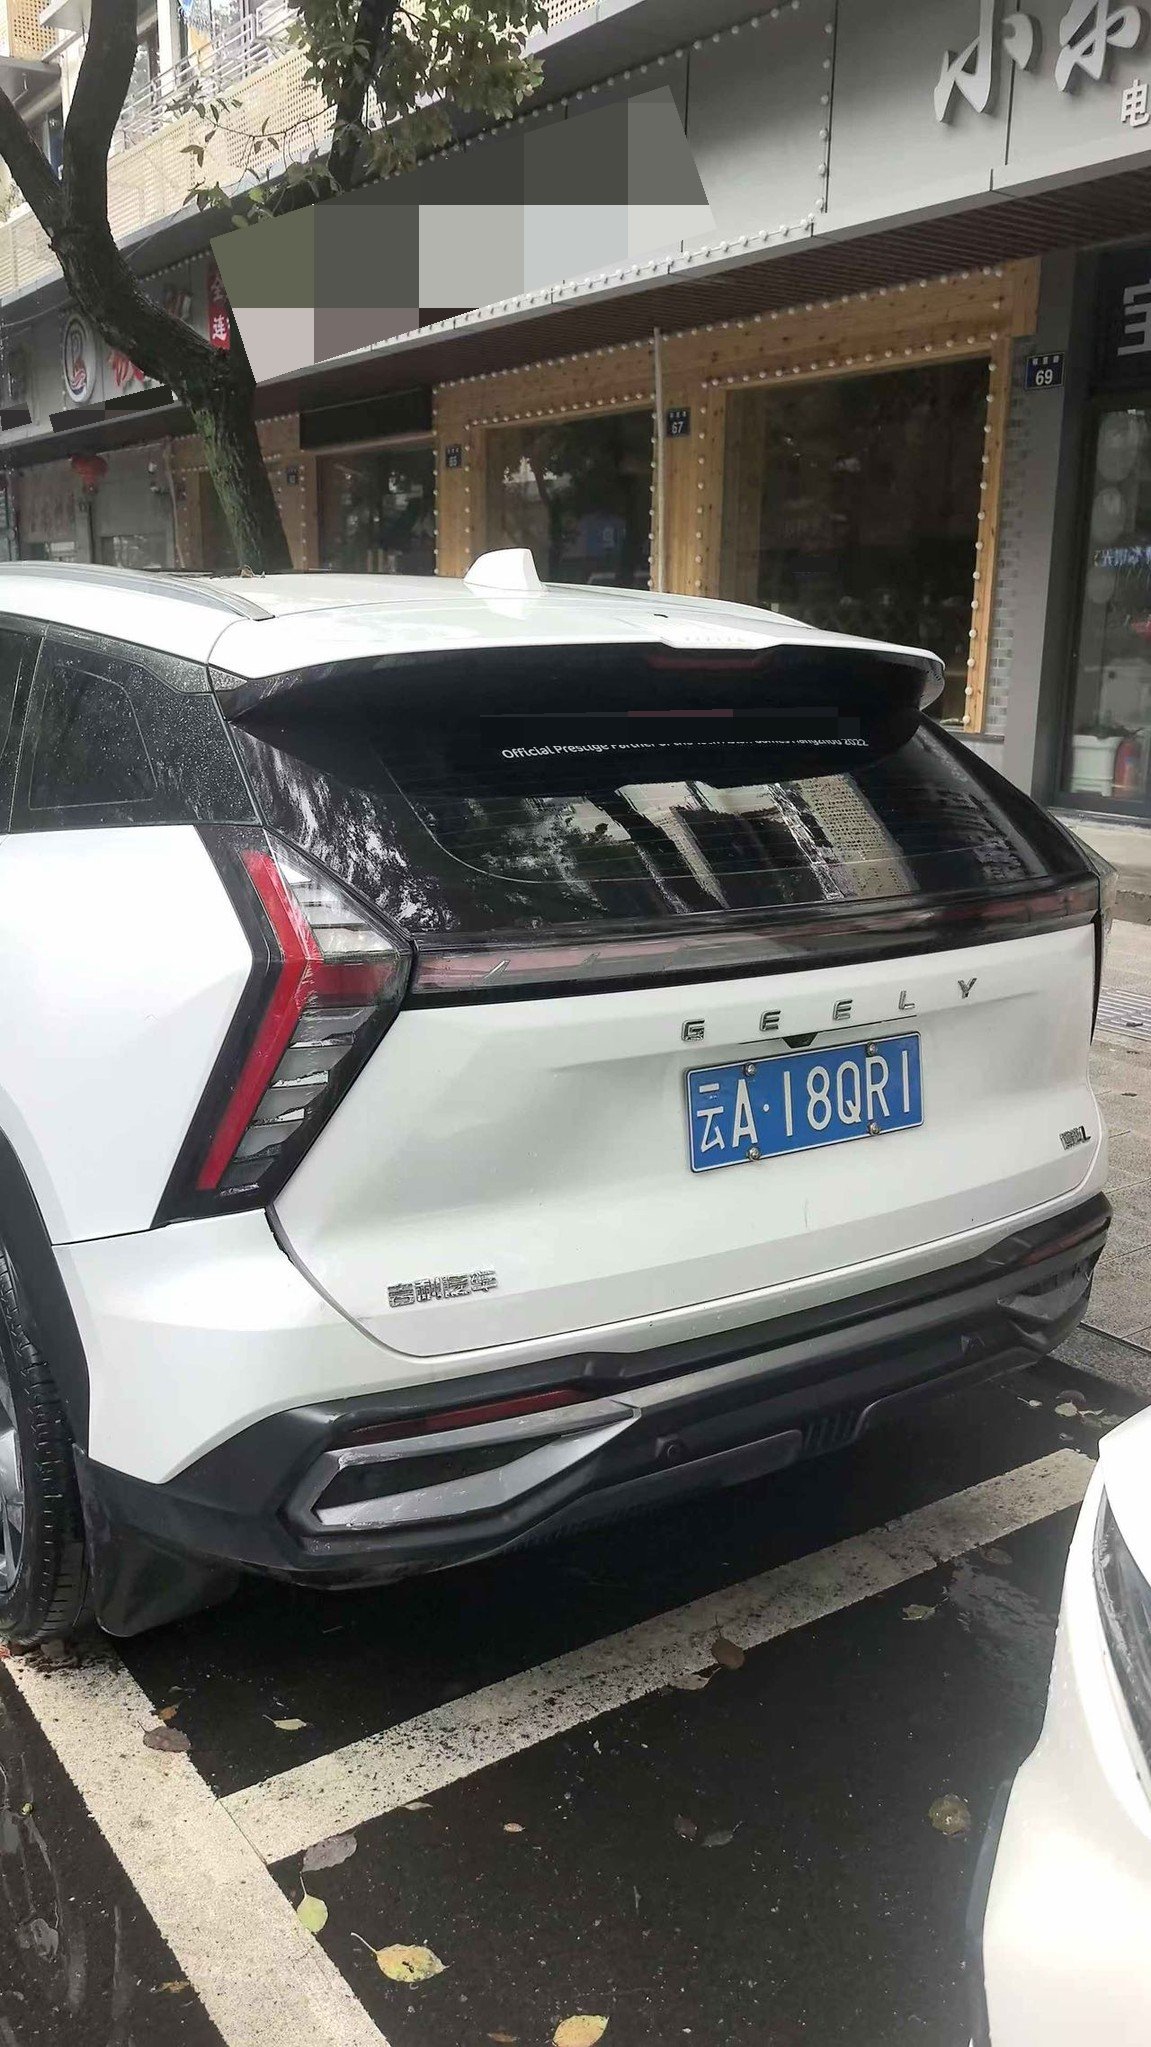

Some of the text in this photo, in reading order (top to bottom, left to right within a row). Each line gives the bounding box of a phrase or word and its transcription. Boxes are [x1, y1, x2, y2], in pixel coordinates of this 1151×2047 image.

[1035, 369, 1053, 386] 69
[671, 420, 684, 434] 67
[501, 742, 555, 759] Official
[681, 977, 978, 1042] GEELY
[387, 1269, 499, 1308] 吉利汽车
